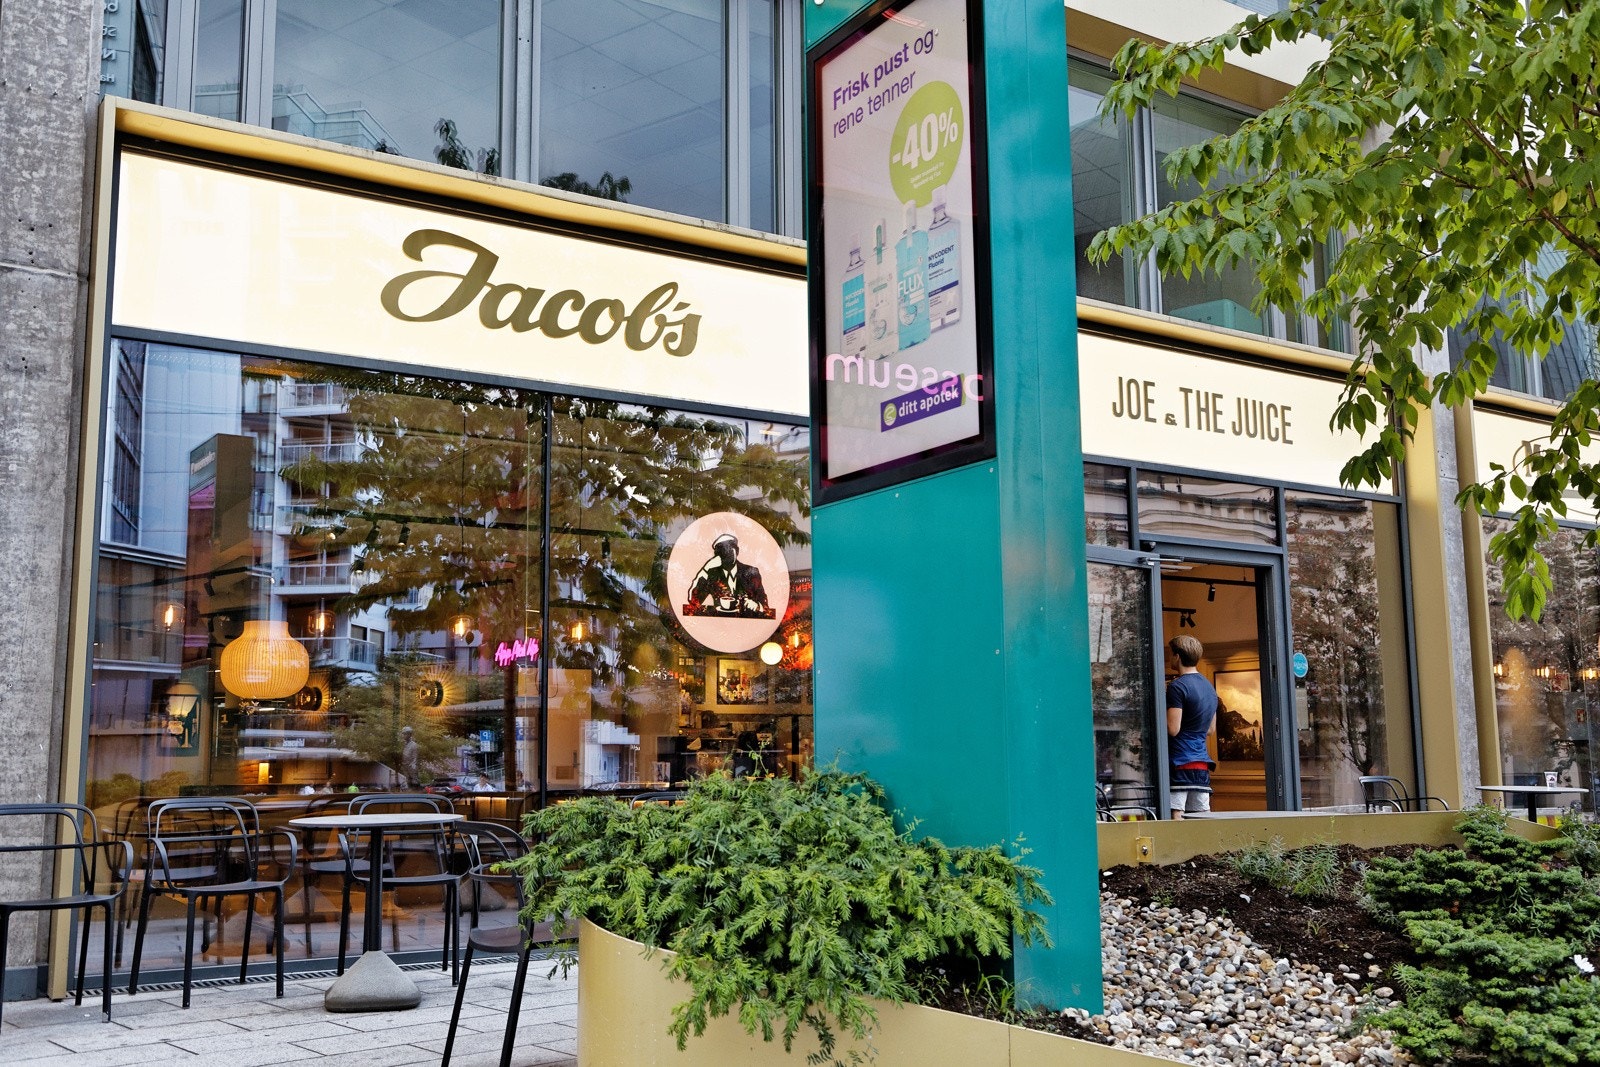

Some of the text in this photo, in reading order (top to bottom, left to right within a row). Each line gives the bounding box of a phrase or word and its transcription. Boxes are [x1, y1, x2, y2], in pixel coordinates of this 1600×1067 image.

[832, 29, 934, 110] Frisk pust og
[832, 71, 916, 138] rene tenner
[892, 107, 958, 170] -40%
[380, 228, 703, 357] Jacob's
[897, 272, 924, 297] FLUX
[898, 385, 959, 417] ditt apotek
[1112, 376, 1294, 445] JOE & THE JUICE
